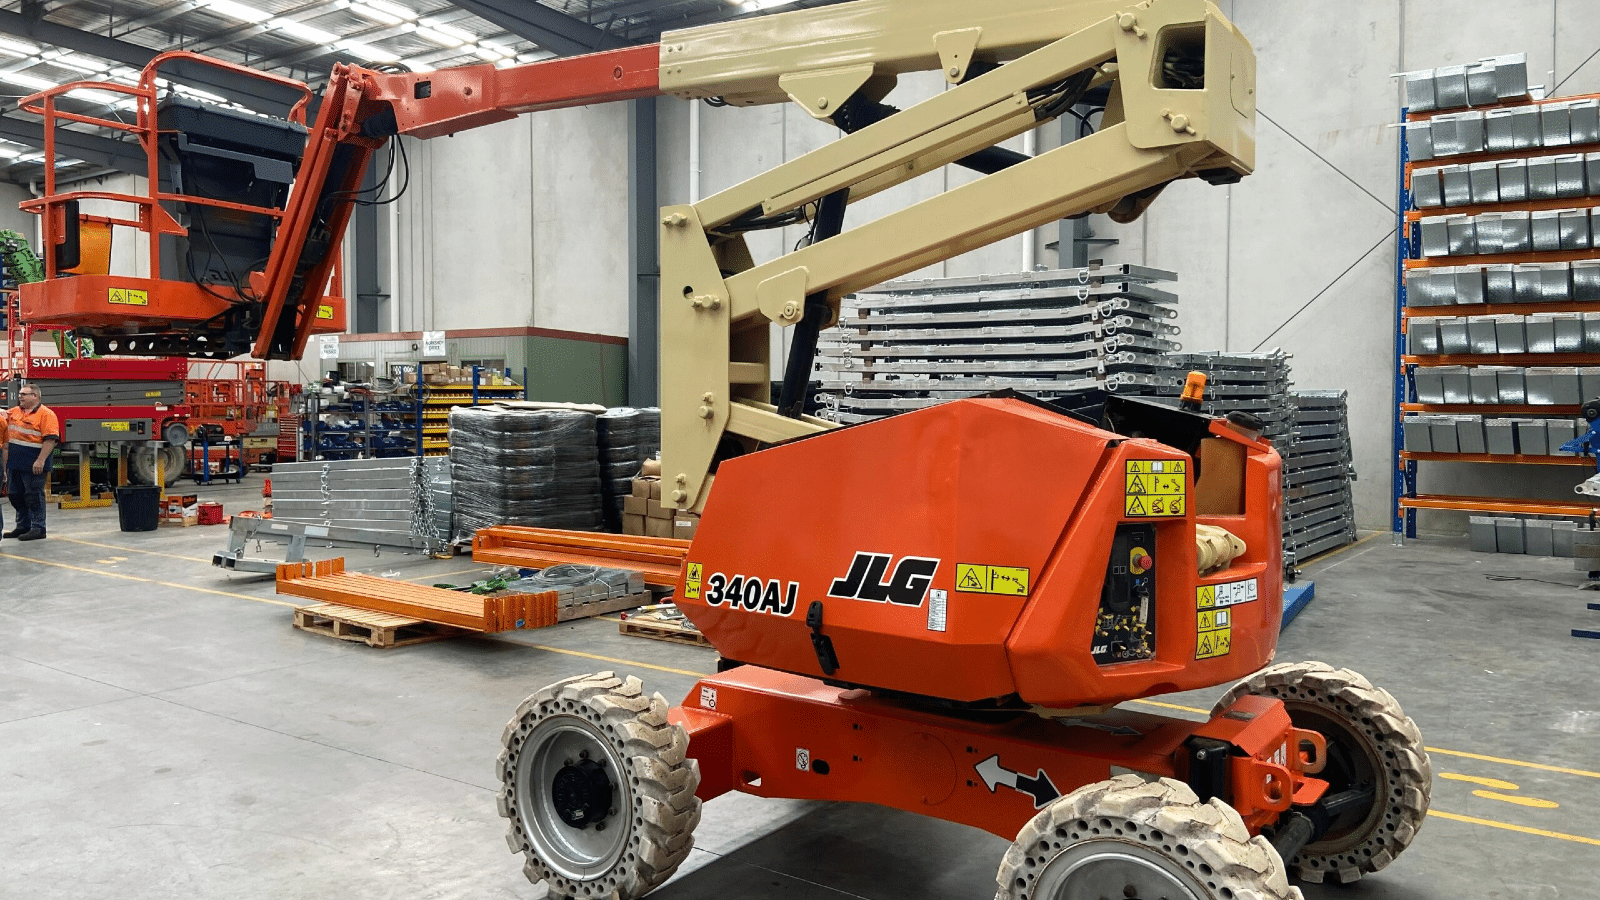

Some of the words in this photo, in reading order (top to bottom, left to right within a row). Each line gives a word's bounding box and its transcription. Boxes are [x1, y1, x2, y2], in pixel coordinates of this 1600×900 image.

[32, 359, 72, 368] SWIFT
[826, 551, 941, 608] JLG
[705, 572, 799, 617] 340AJ
[1091, 644, 1108, 655] JLG
